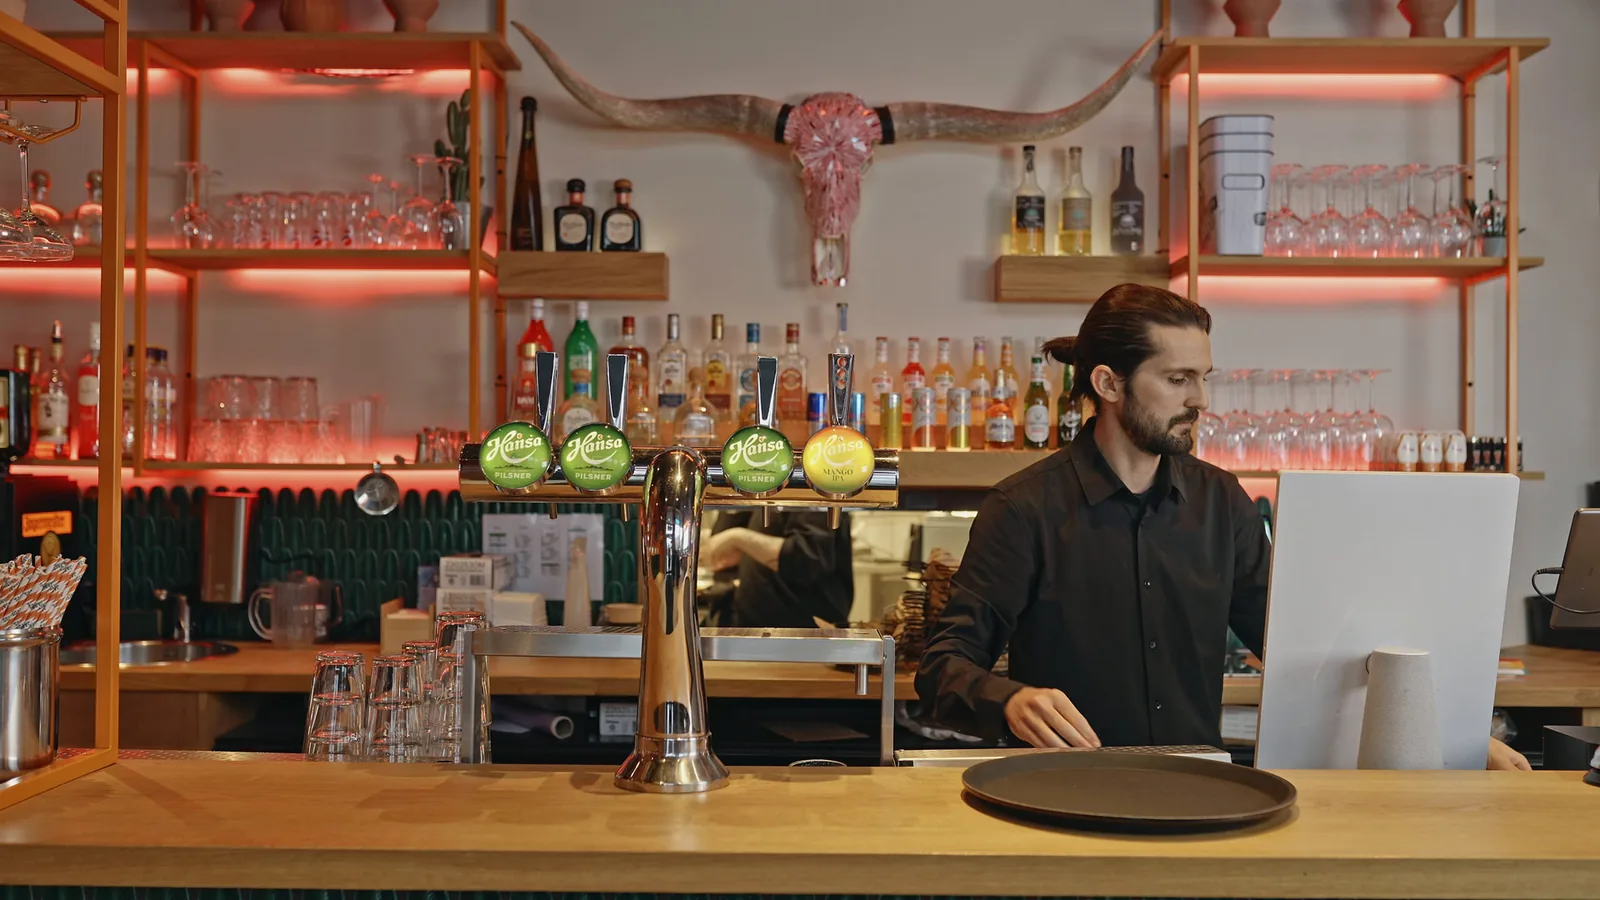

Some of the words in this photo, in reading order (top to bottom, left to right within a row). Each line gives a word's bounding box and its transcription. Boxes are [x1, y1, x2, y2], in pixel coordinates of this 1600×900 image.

[485, 430, 542, 464] Hansa
[566, 431, 623, 465] Hansa
[729, 433, 784, 467] Hansa
[810, 434, 864, 467] Hansa
[494, 471, 532, 479] PILSNER
[574, 472, 612, 481] PILSNER
[738, 475, 776, 483] PILSNER
[823, 468, 854, 476] MANGO
